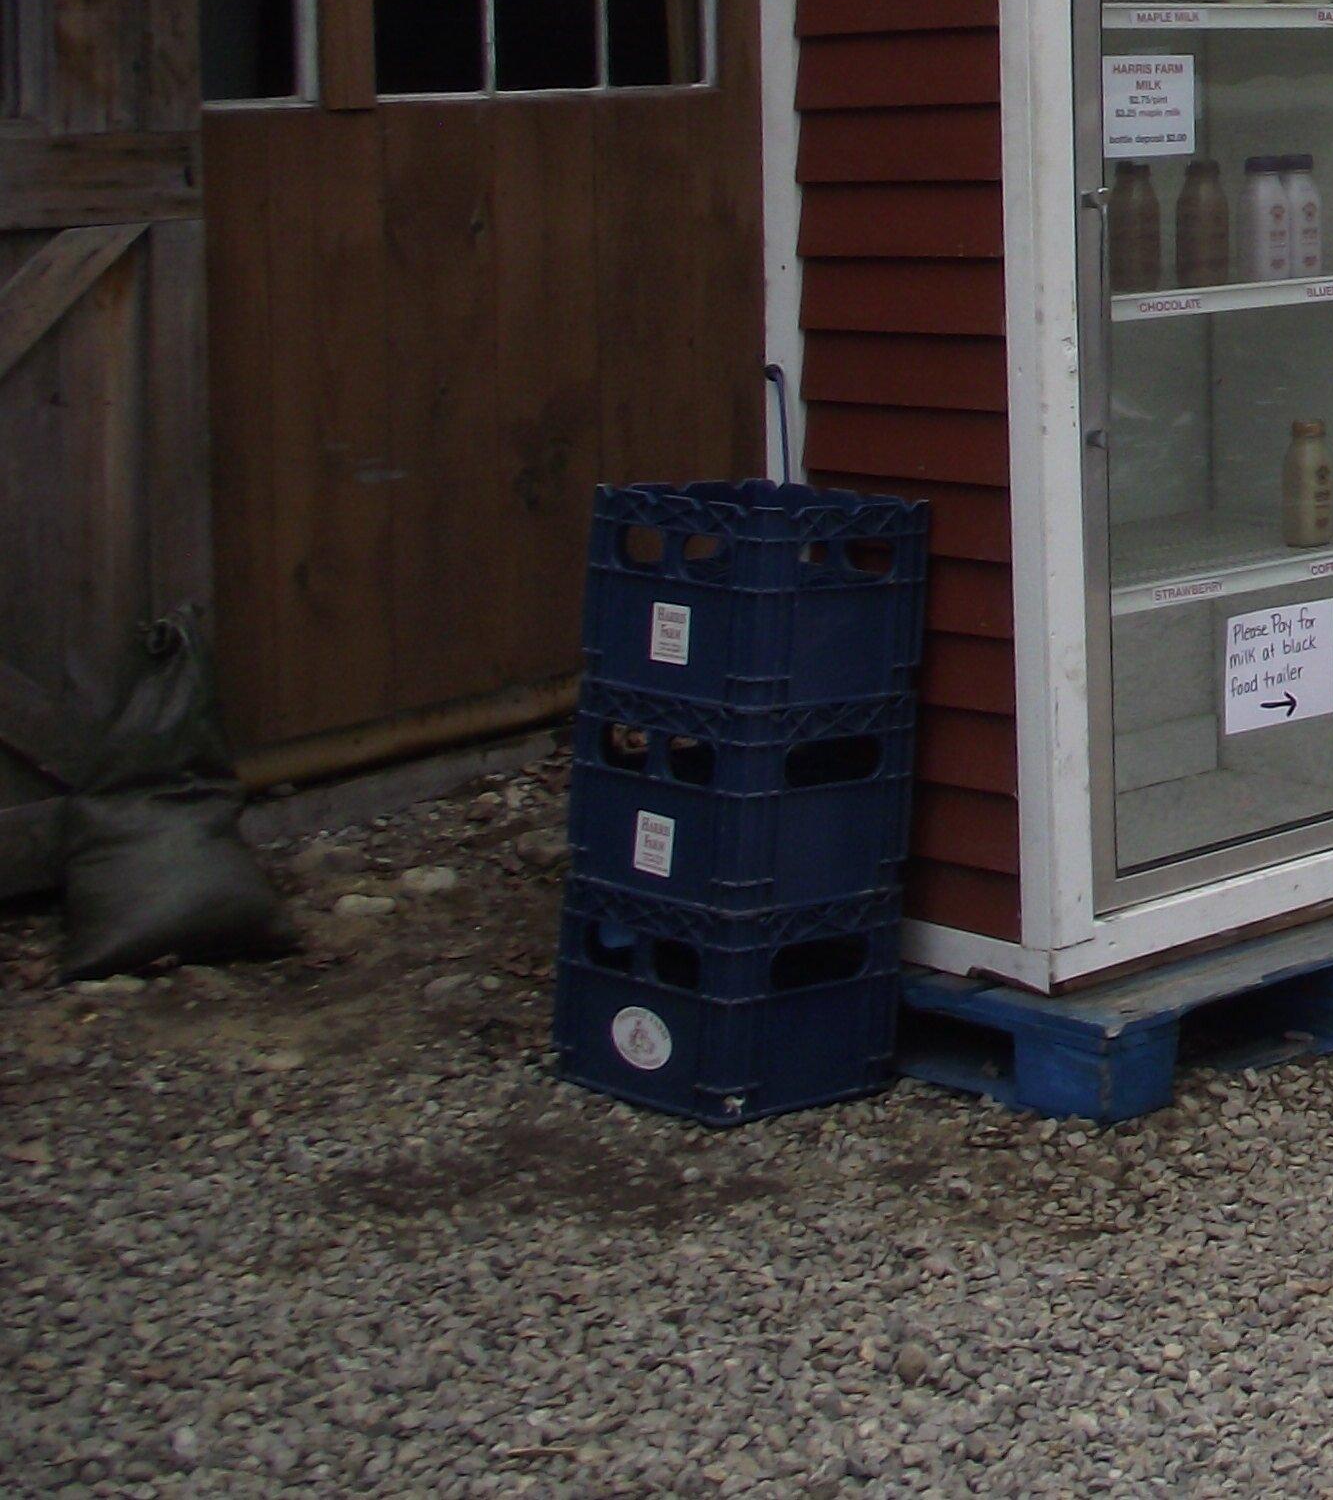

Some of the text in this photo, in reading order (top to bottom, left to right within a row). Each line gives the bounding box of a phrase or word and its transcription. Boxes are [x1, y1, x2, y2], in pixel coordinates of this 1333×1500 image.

[1136, 11, 1173, 23] MAPLE
[1112, 63, 1184, 75] HARRIS FARM
[1135, 80, 1163, 91] MILK
[1134, 133, 1165, 146] deposit
[1139, 298, 1202, 314] CHOCOLATE
[1154, 581, 1224, 601] STRAWBERRY
[1232, 607, 1316, 645] Please Pay for
[1262, 643, 1275, 661] at
[1282, 634, 1317, 655] black
[1231, 663, 1304, 698] food trailer
